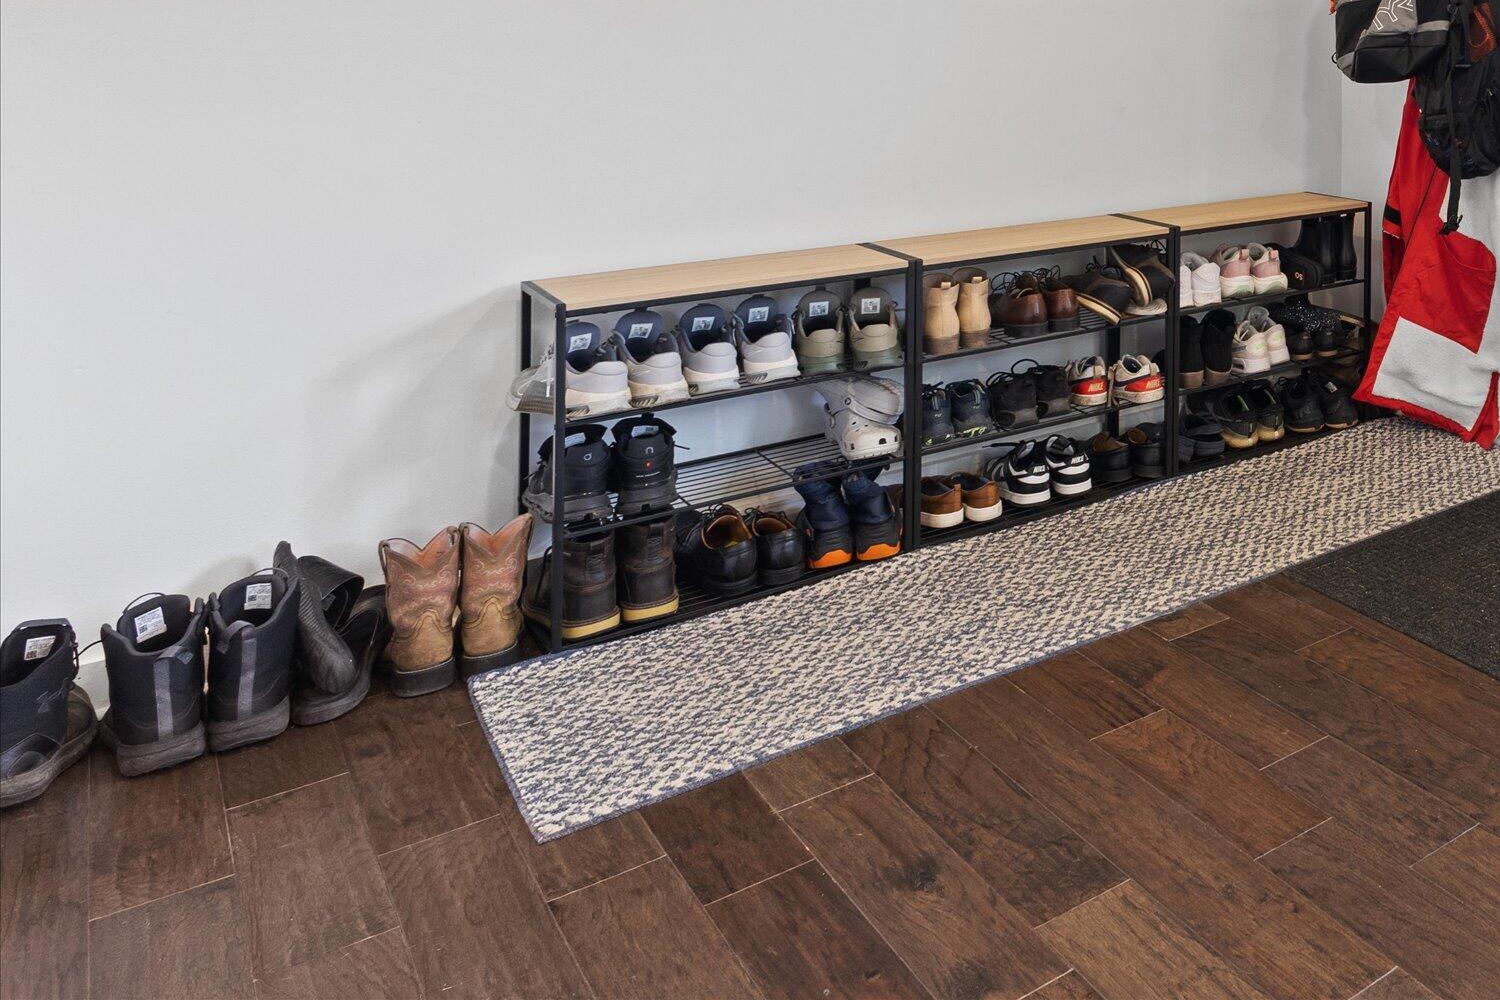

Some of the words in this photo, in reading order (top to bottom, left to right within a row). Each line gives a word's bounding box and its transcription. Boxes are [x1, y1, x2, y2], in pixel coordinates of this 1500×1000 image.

[1088, 382, 1104, 392] NIKE
[1071, 455, 1084, 465] NIKE
[1033, 465, 1046, 474] NIKE
